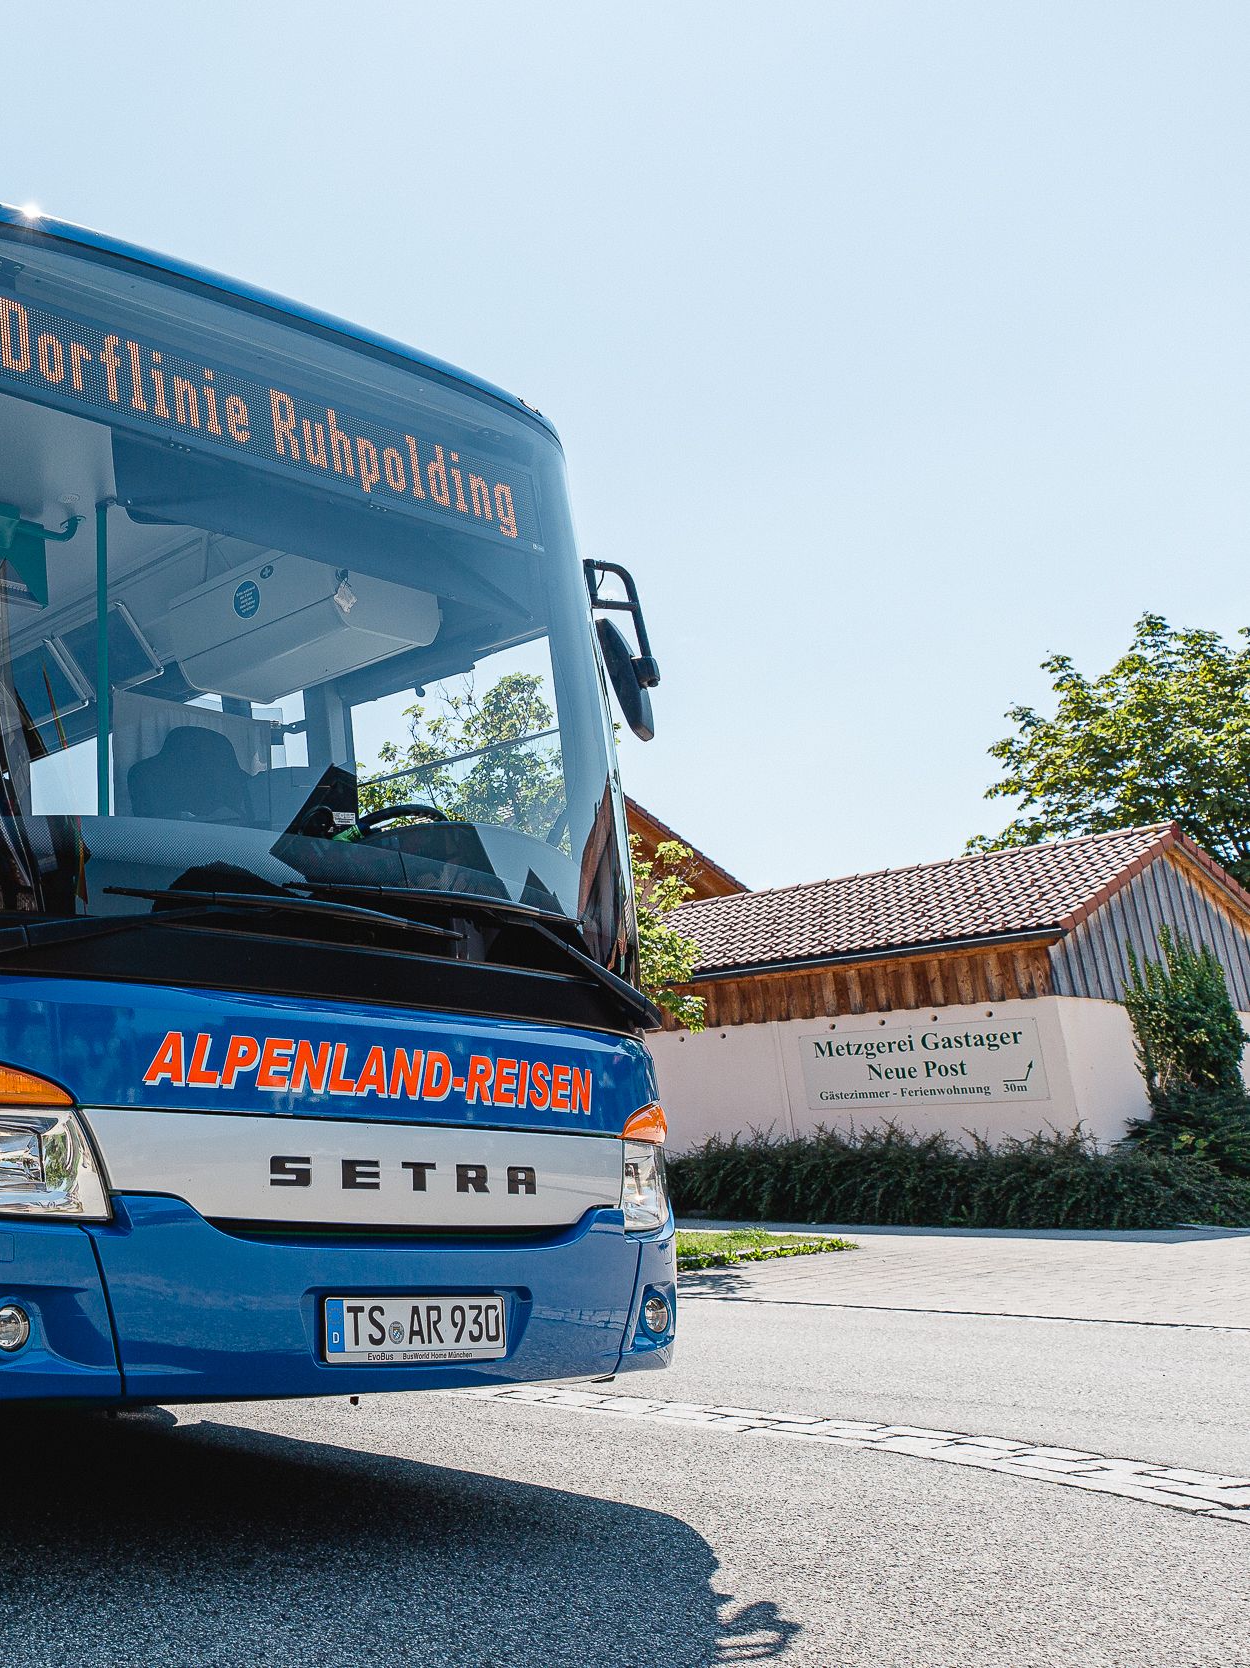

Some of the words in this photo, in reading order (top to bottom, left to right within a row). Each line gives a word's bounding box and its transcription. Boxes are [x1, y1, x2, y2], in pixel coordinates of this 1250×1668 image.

[270, 388, 518, 539] Ruhpolding
[813, 1034, 915, 1060] Metzgerei
[920, 1029, 1023, 1052] Gastager
[142, 1031, 592, 1115] ALPENLAND-REISEN
[866, 1062, 918, 1081] Neue
[922, 1059, 968, 1079] Post
[819, 1088, 891, 1101] Gästezimmer
[900, 1083, 992, 1097] Ferienwohnung
[1003, 1083, 1028, 1093] 30m
[269, 1155, 537, 1196] SETRA
[332, 1331, 340, 1344] D
[346, 1305, 386, 1347] TS
[408, 1305, 444, 1344] AR
[450, 1304, 501, 1344] 930
[367, 1352, 394, 1361] EvoBus
[402, 1352, 430, 1360] BusWorld
[430, 1352, 447, 1360] Home
[447, 1351, 473, 1359] München
